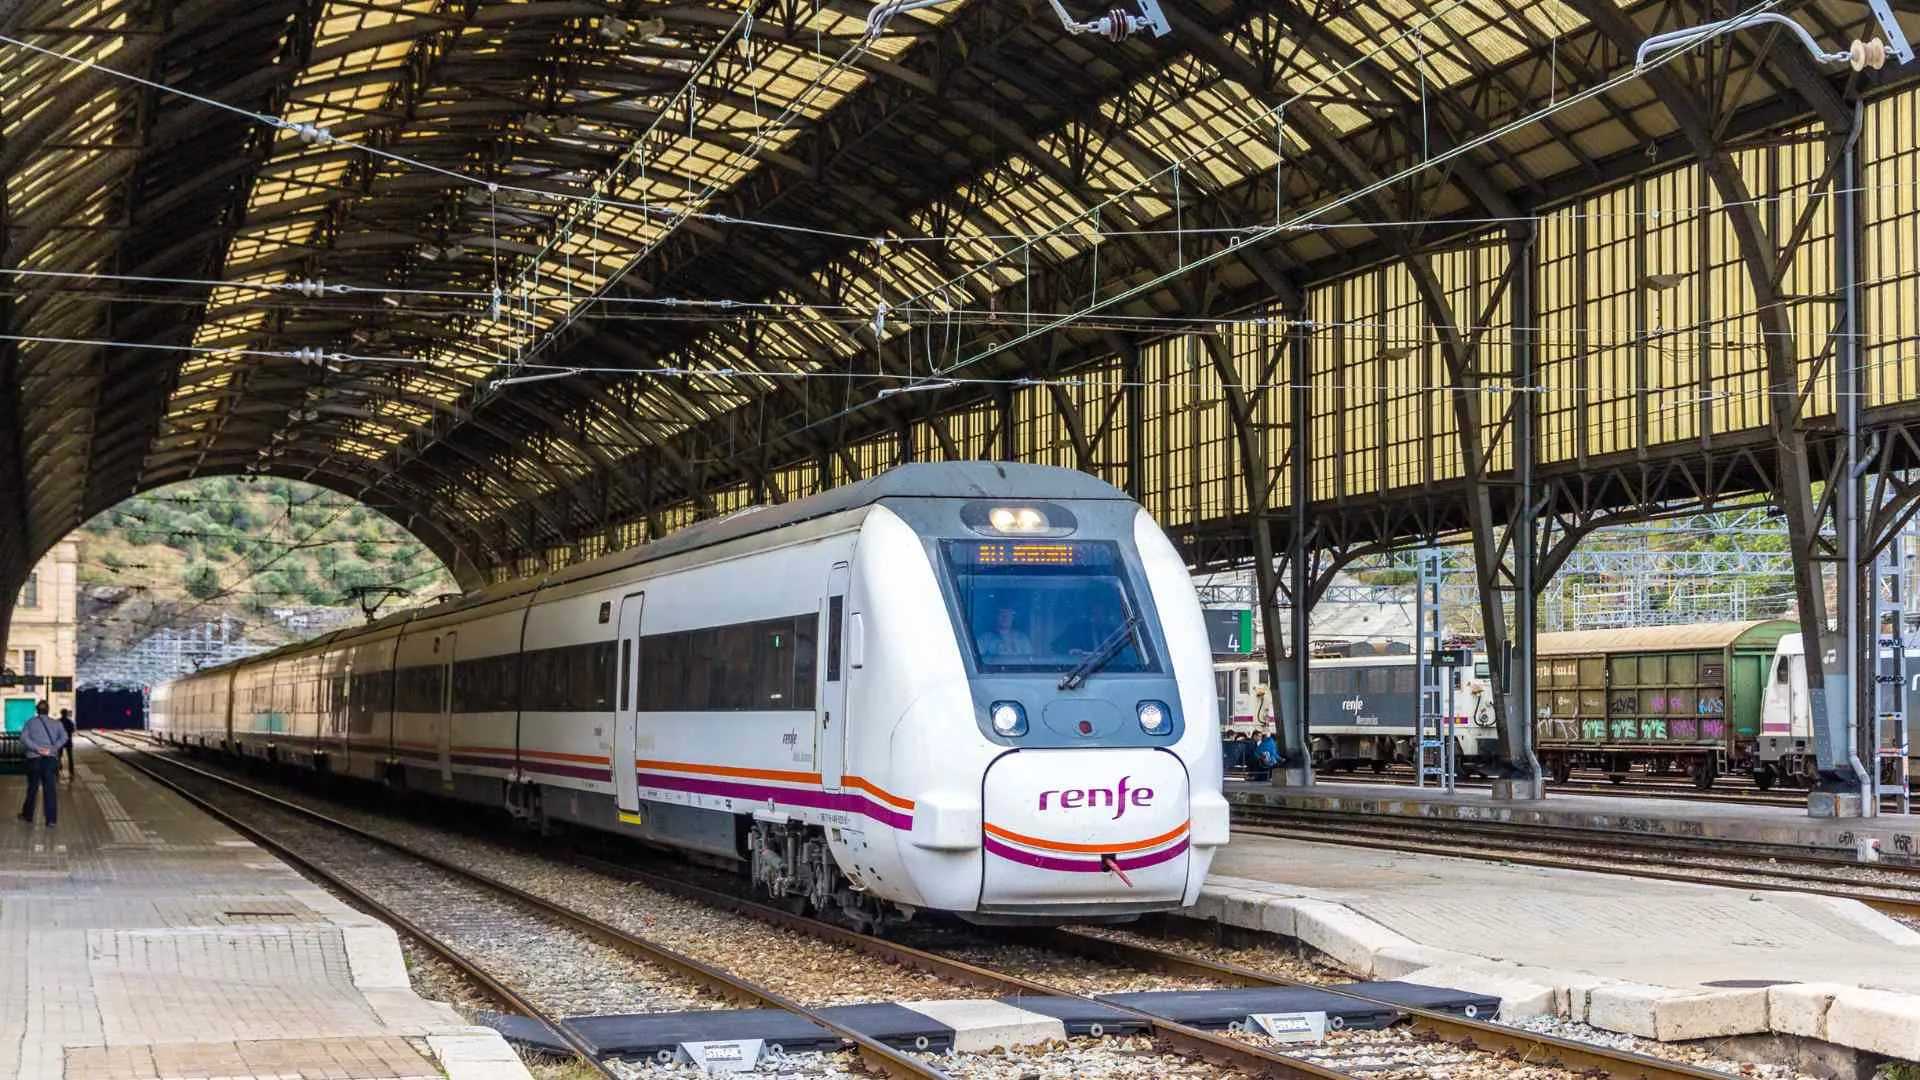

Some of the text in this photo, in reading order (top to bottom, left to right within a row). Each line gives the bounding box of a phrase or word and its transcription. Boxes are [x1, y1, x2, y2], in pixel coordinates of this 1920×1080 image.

[1228, 634, 1240, 652] 4
[1342, 695, 1364, 715] renfe
[1038, 775, 1154, 820] renfe
